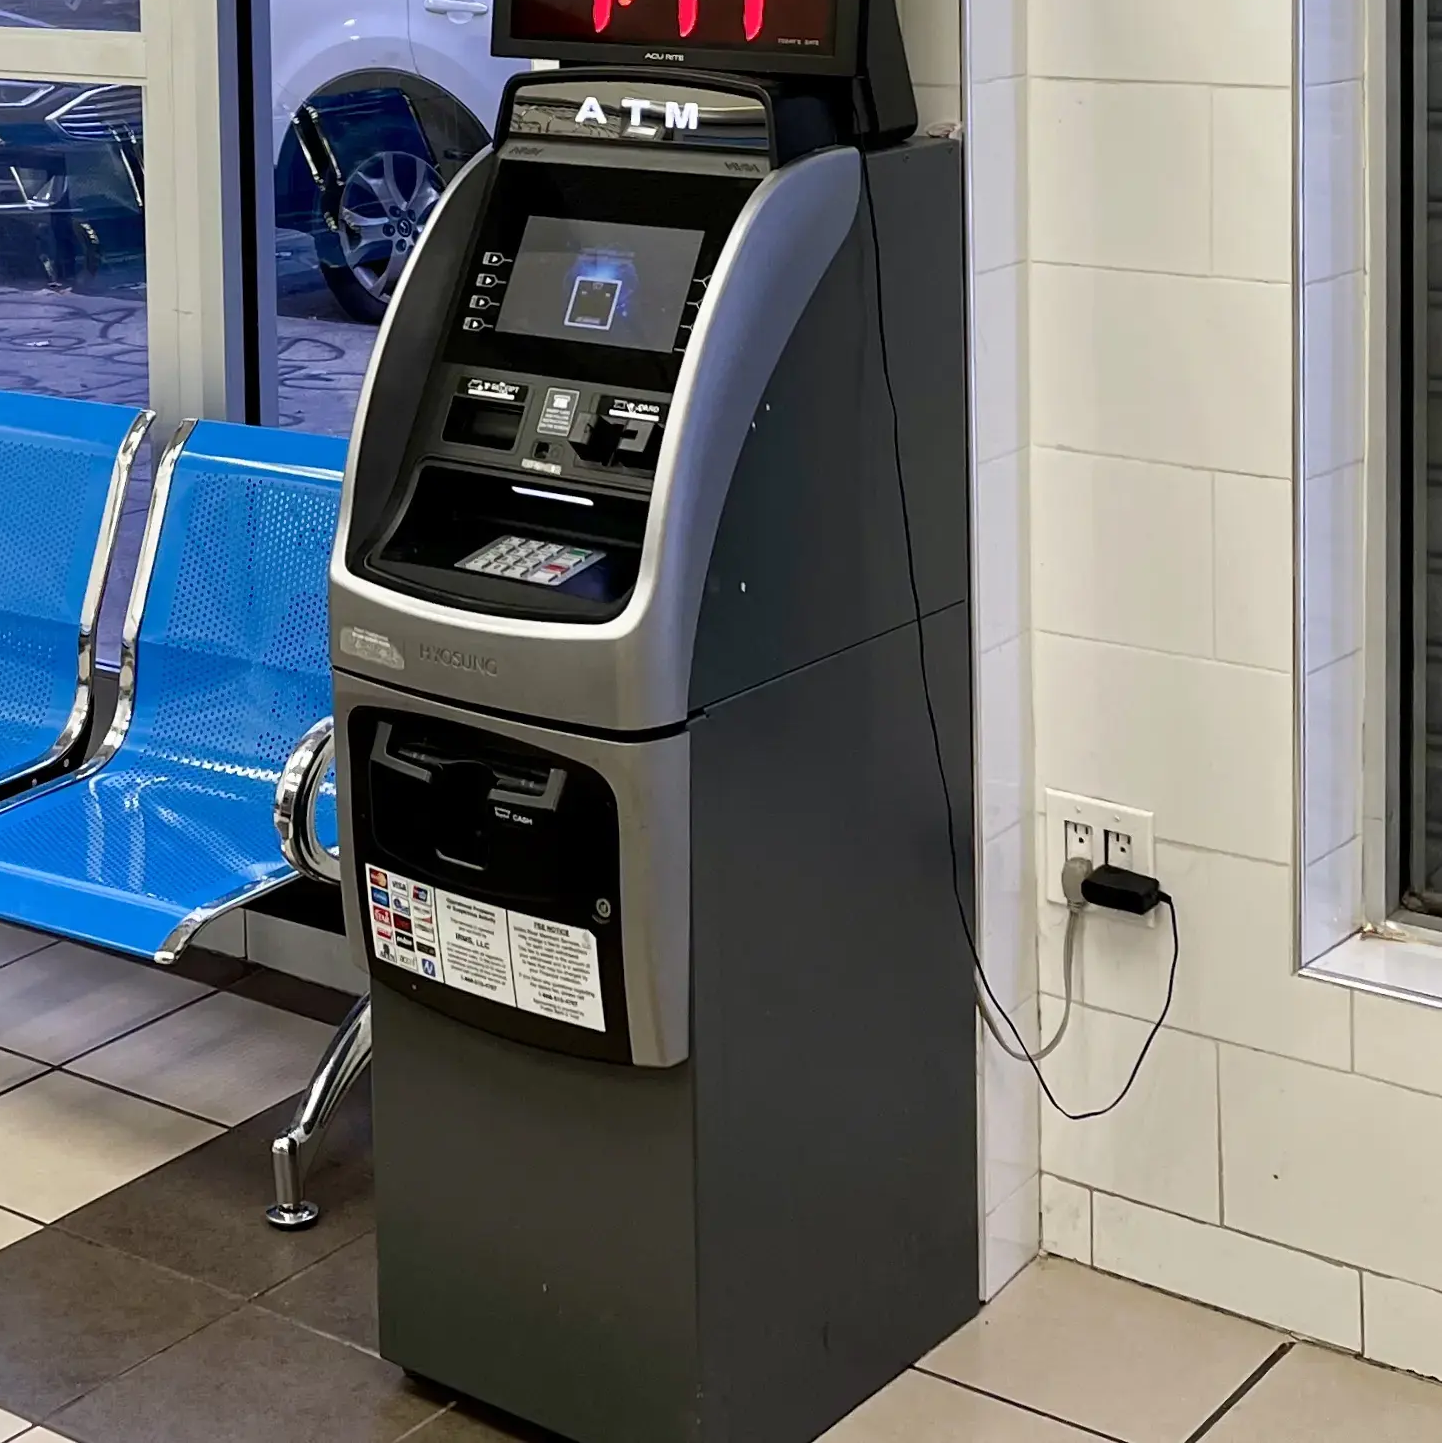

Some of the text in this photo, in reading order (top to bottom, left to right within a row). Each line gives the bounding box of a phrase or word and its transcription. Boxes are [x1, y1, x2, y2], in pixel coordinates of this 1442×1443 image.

[804, 39, 819, 47] DATE
[574, 96, 699, 130] ATM
[419, 643, 498, 677] HYOSUNG
